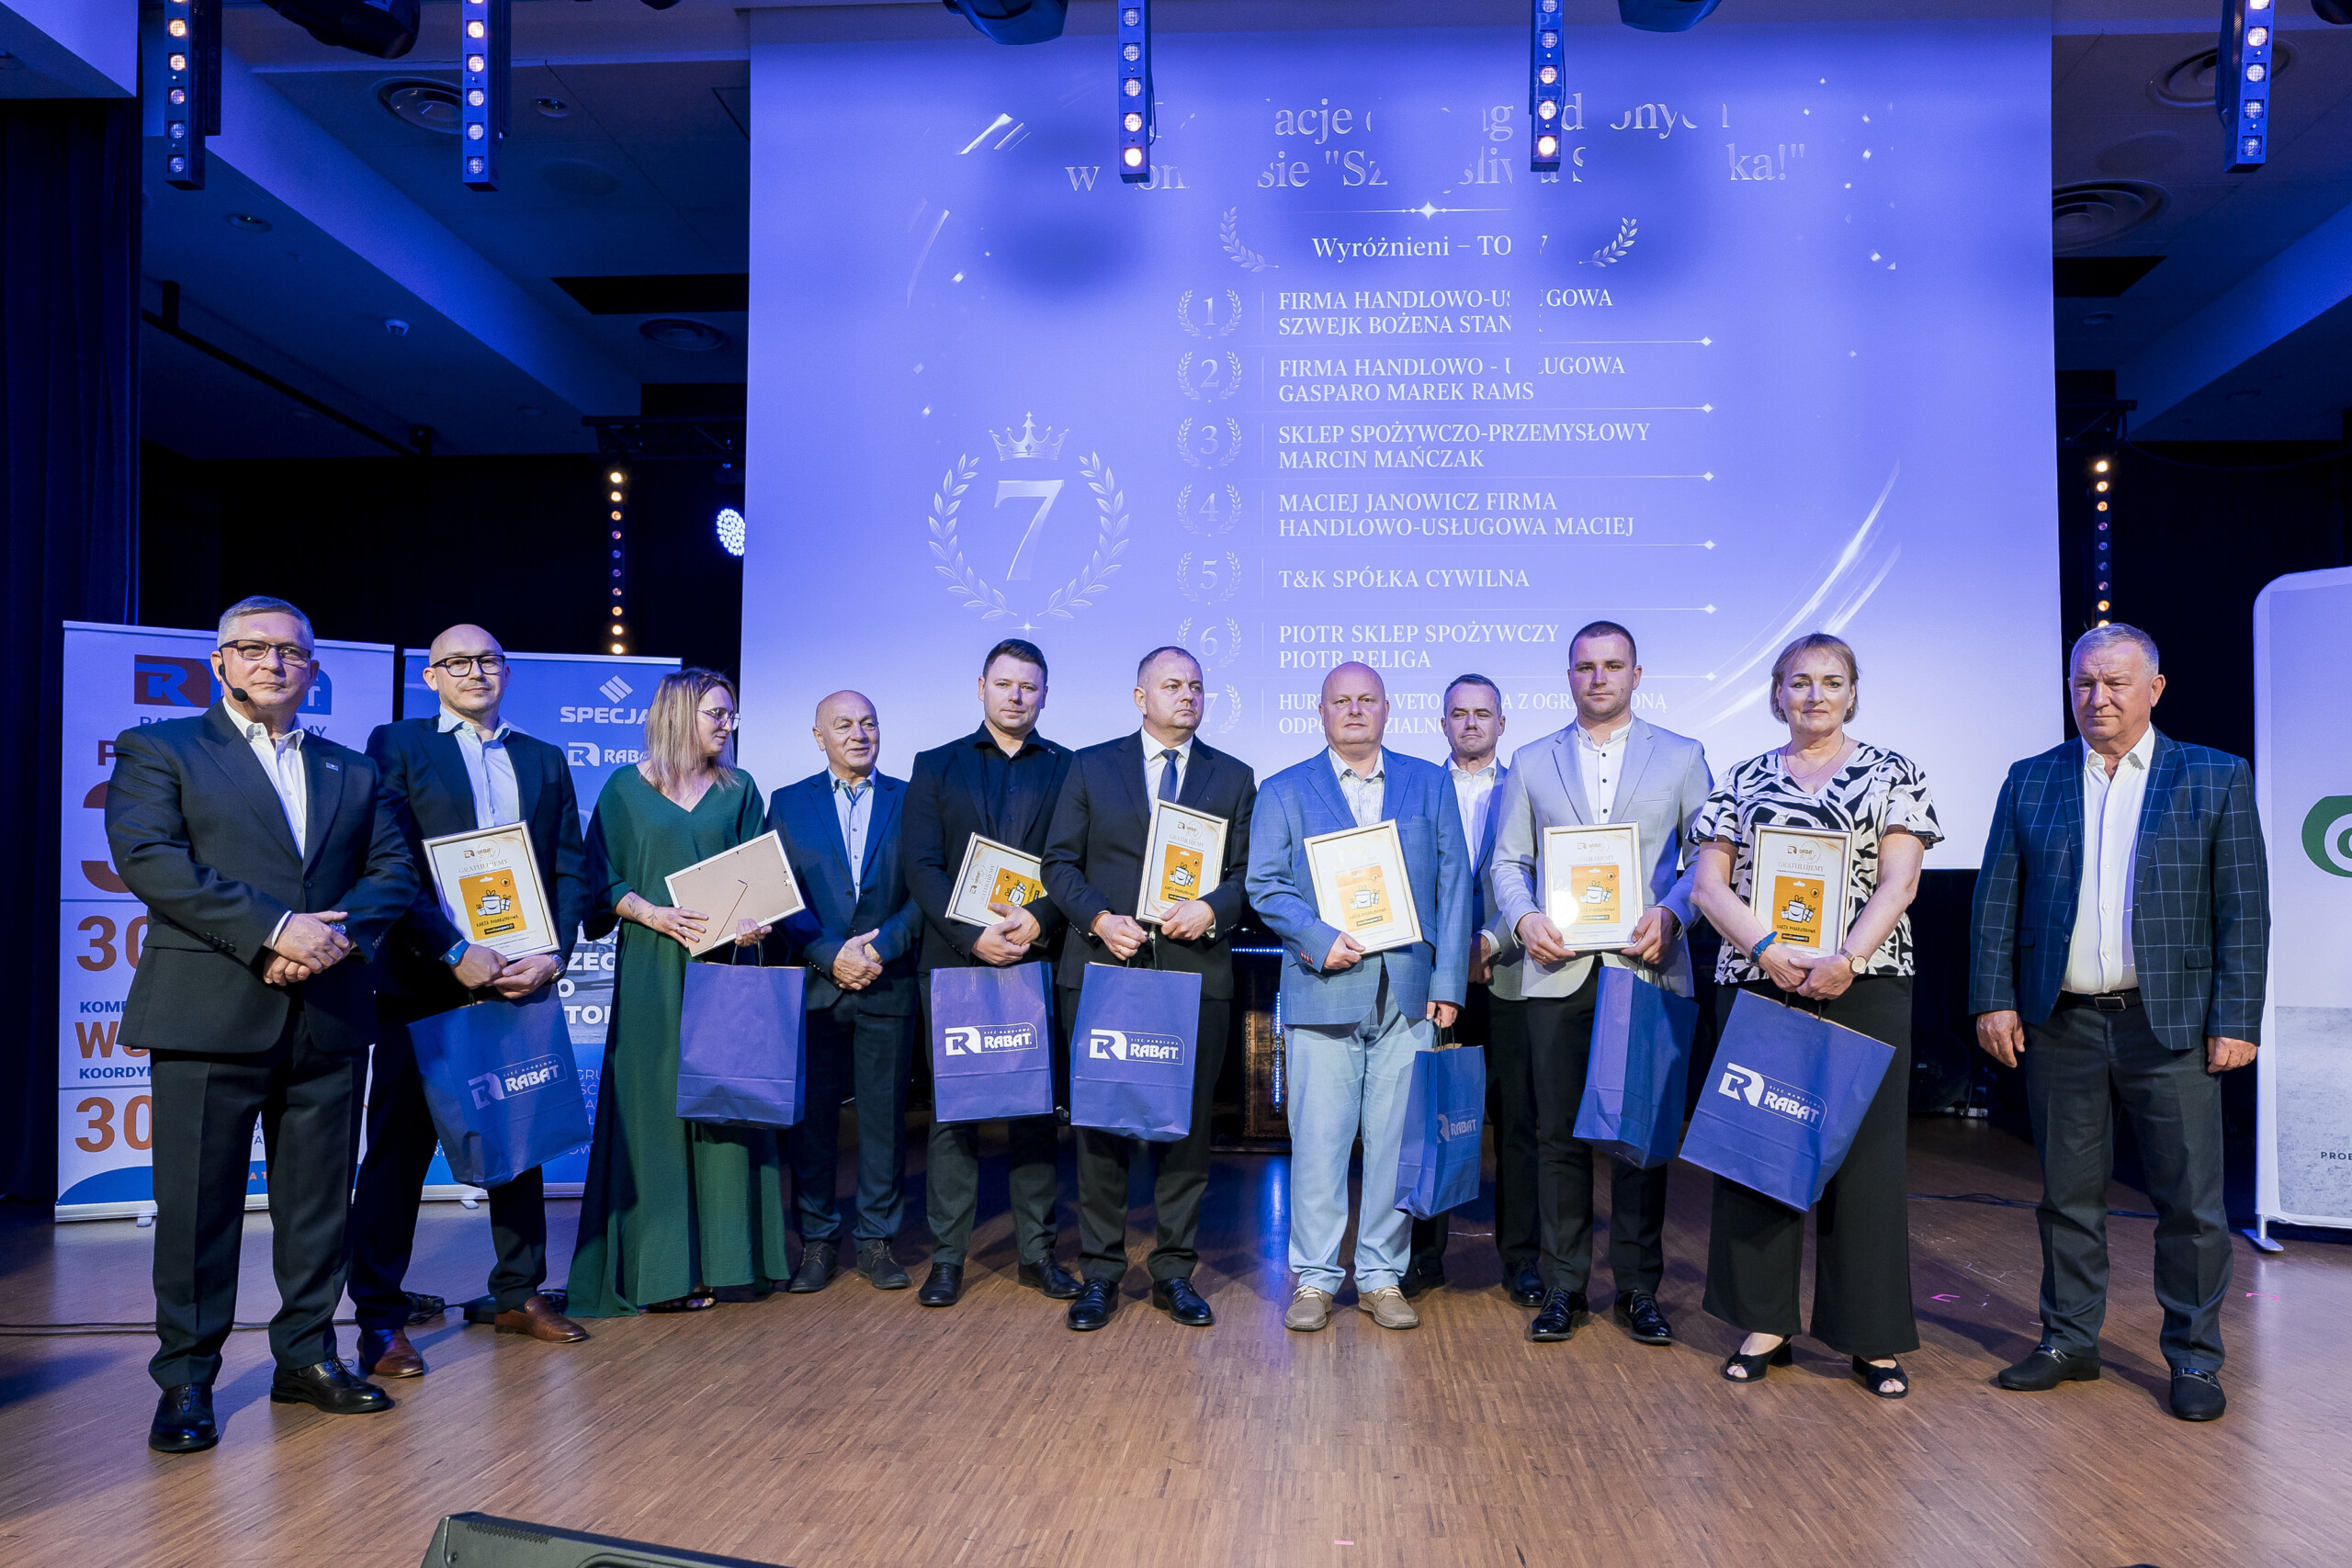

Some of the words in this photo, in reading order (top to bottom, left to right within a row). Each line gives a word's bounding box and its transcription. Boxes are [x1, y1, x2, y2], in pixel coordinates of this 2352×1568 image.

[1312, 236, 1450, 263] Wyróżnieni
[1204, 297, 1216, 325] 1
[1279, 292, 1348, 310] FIRMA
[1279, 317, 1363, 336] SZWEJK
[1369, 311, 1453, 334] BOŻENA
[1200, 359, 1219, 388] 2
[1279, 359, 1348, 377] FIRMA
[1354, 357, 1483, 376] HANDLOWO
[1279, 384, 1380, 401] GASPARO
[1387, 383, 1465, 400] MAREK
[1472, 382, 1534, 400] RAMS
[1200, 425, 1218, 454] 3
[1279, 425, 1344, 444] SKLEP
[1351, 421, 1650, 443] SPOŻYWCZO-PRZEMYSŁOWY
[1279, 451, 1367, 468] MARCIN
[1374, 446, 1485, 468] MAŃCZAK
[1199, 492, 1219, 521] 4
[1279, 494, 1357, 513] MACIEJ
[1365, 493, 1479, 513] JANOWICZ
[1486, 492, 1557, 511] FIRMA
[994, 479, 1065, 581] 7
[1279, 517, 1547, 536] HANDLOWO-USŁUGOWA
[1555, 517, 1634, 536] MACIEJ
[1200, 560, 1218, 589] 5
[1279, 570, 1326, 588] T&K
[1333, 565, 1419, 588] SPÓŁKA
[1426, 570, 1530, 587] CYWILNA
[1200, 626, 1218, 656] 6
[1279, 626, 1343, 643] PIOTR
[1351, 625, 1419, 642] SKLEP
[1425, 620, 1559, 642] SPOŻYWCZY
[1279, 650, 1343, 668] PIOTR
[1352, 649, 1431, 668] RELIGA
[1394, 694, 1441, 710] VETO
[1518, 694, 1529, 709] Z
[983, 1032, 1032, 1049] RABAT
[1129, 1043, 1179, 1059] RABAT
[504, 1065, 559, 1091] RABAT
[1763, 1090, 1820, 1123] RABAT
[75, 1095, 153, 1153] 30
[1450, 1119, 1476, 1135] RABAT
